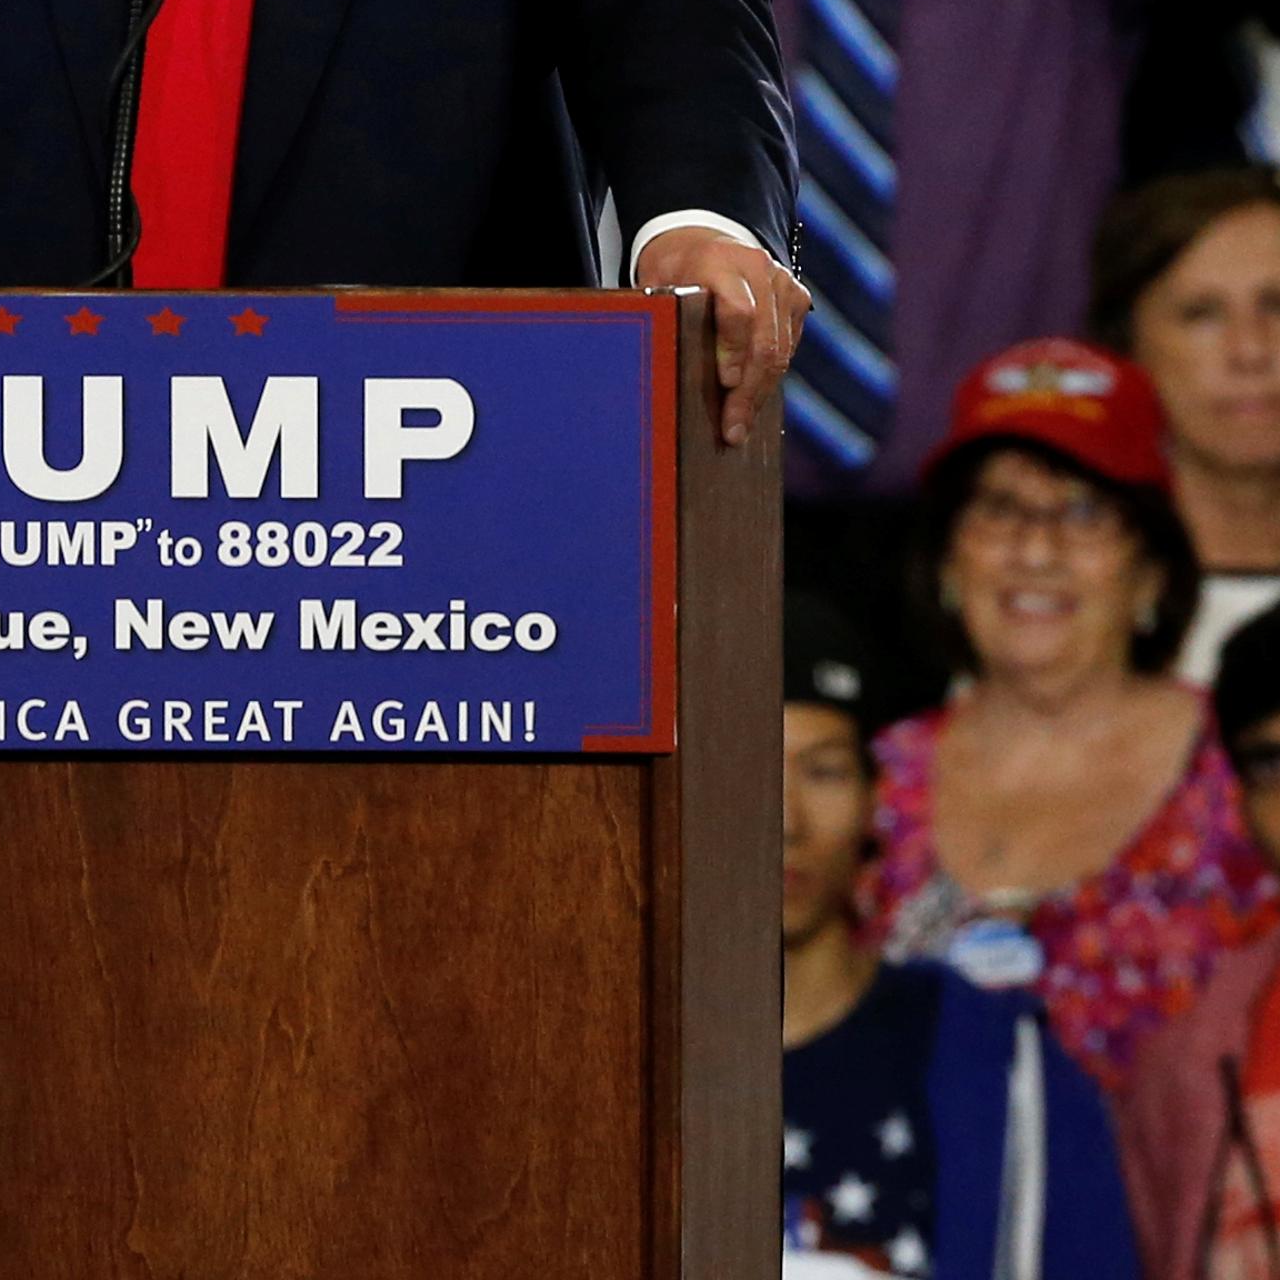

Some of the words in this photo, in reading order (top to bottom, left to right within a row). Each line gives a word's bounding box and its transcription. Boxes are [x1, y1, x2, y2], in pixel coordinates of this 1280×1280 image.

[157, 531, 203, 567] to
[217, 521, 404, 567] 88022
[115, 598, 275, 650] New
[300, 599, 557, 651] Mexico
[118, 699, 303, 742] GREAT
[329, 700, 535, 742] AGAIN!
